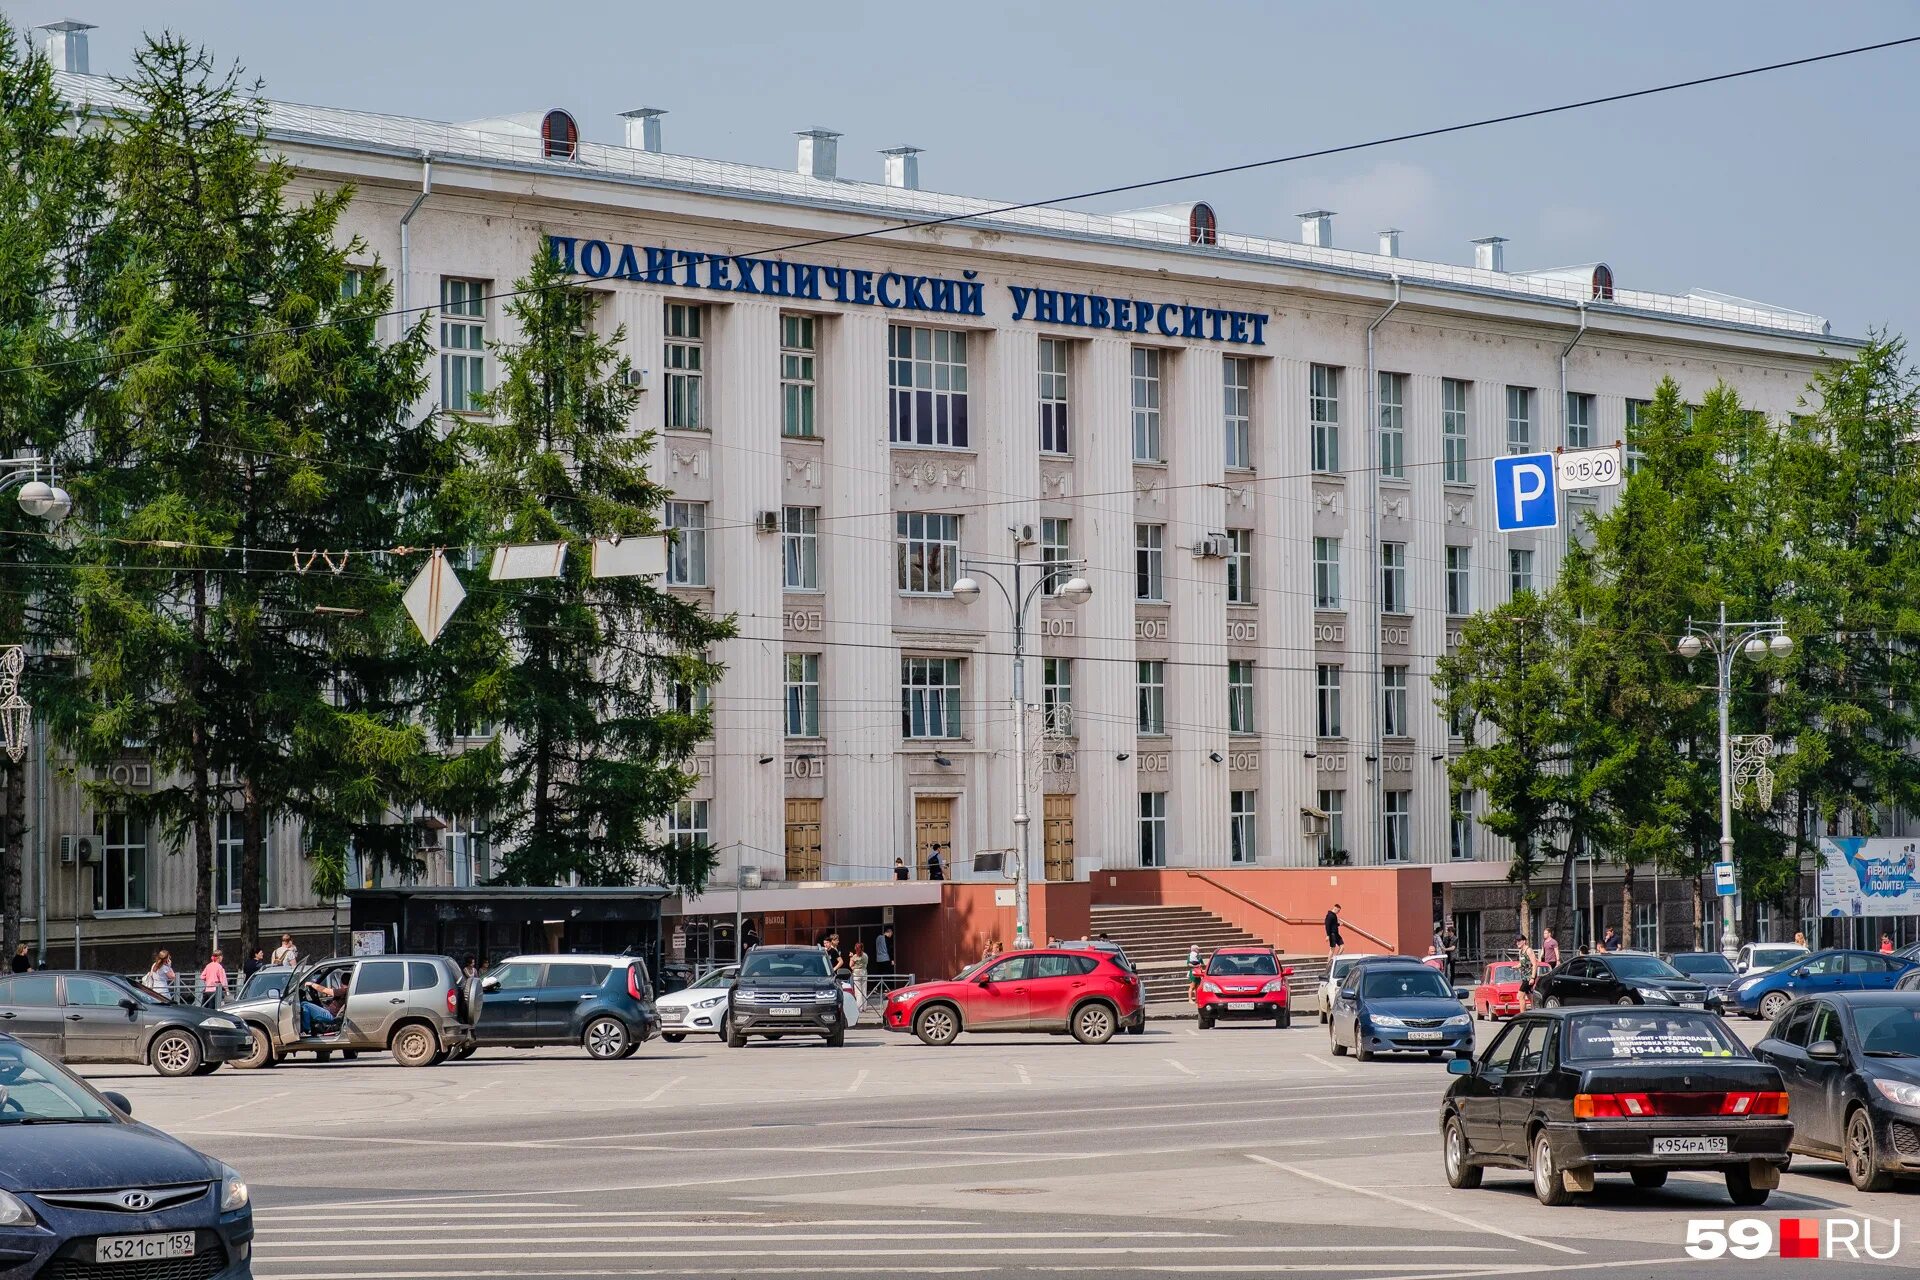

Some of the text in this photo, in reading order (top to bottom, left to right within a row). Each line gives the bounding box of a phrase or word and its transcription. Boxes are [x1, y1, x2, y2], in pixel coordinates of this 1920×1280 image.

[548, 236, 1269, 345] ПОЛИТЕХНИЧЕСКИЙ УНИВЕРСИТЕТ
[1566, 460, 1613, 476] 10 15 20
[1867, 863, 1907, 876] ПЕРМСКИЙ
[1871, 880, 1905, 891] ПОЛИТЕХ
[1612, 1046, 1703, 1054] 8-919-44-99-500
[1658, 1138, 1724, 1152] К954РА 159
[103, 1235, 191, 1260] К521СТ 159
